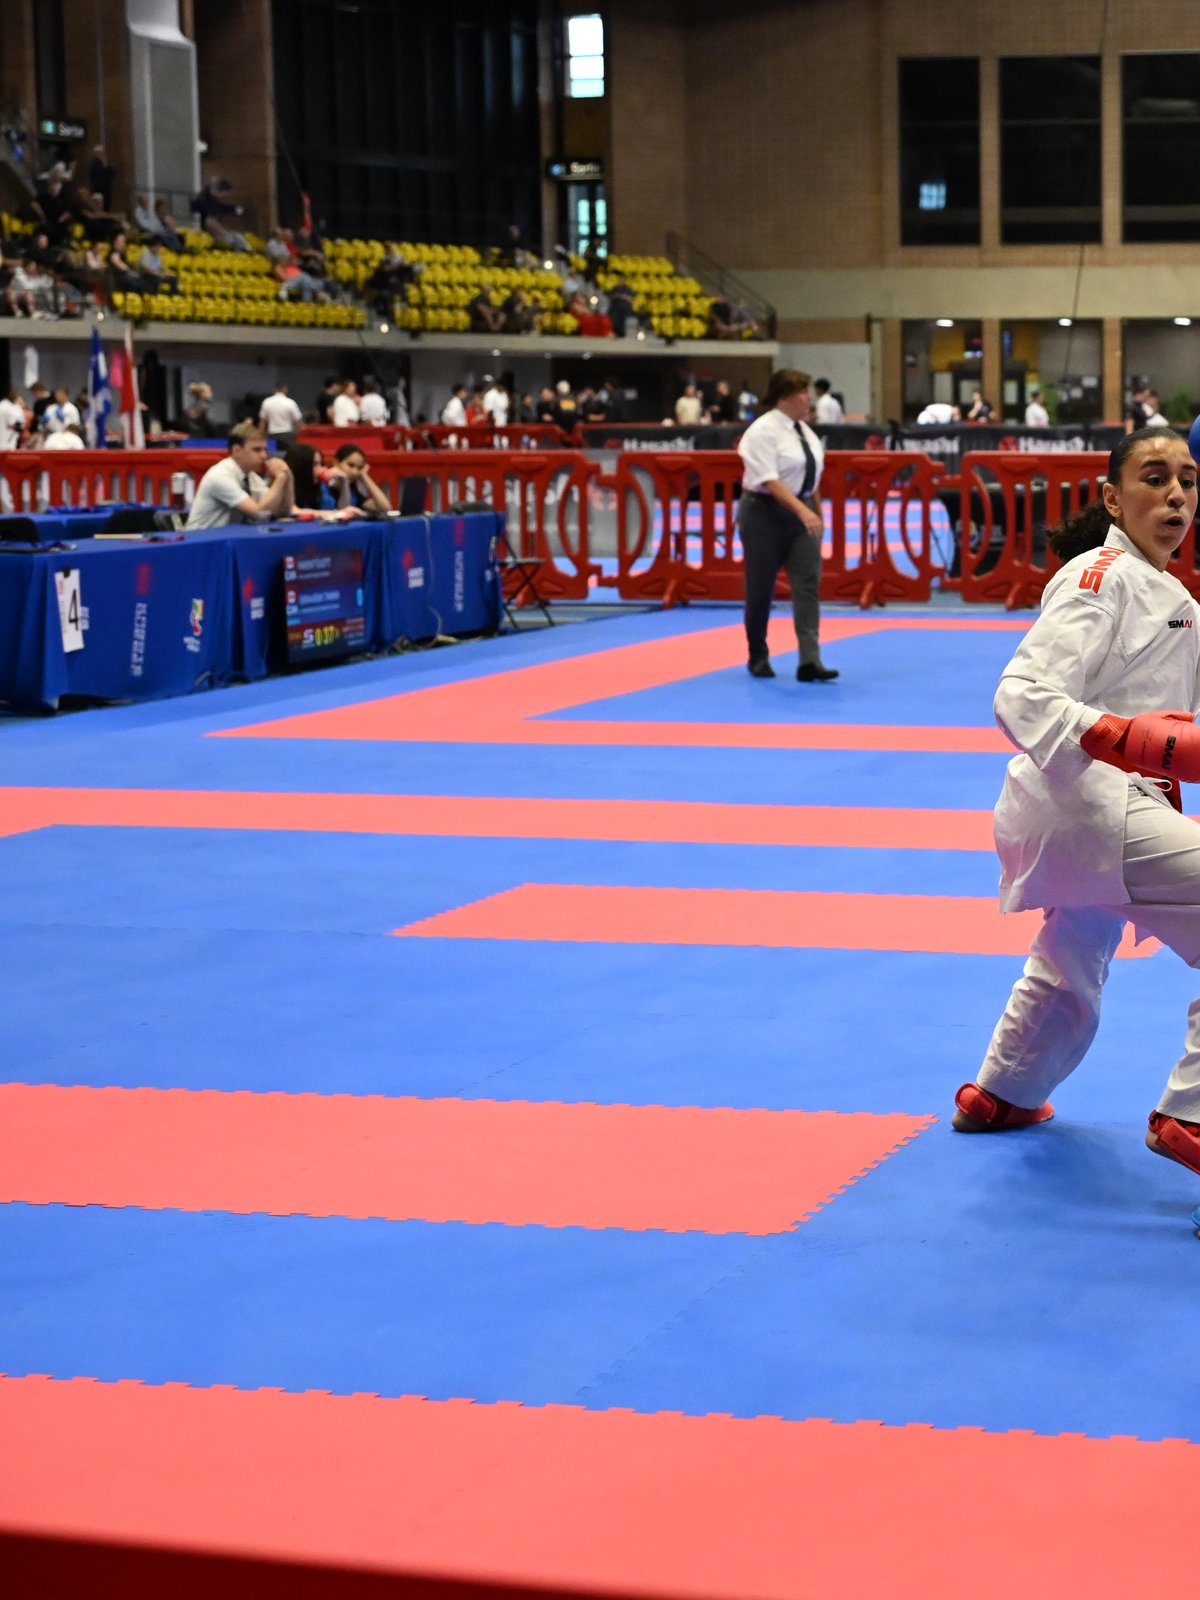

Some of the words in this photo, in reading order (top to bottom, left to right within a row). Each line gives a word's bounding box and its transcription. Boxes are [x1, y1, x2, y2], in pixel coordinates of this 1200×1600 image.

[68, 589, 79, 631] 4
[1167, 619, 1192, 629] SMAI
[1162, 735, 1176, 770] SMAI
